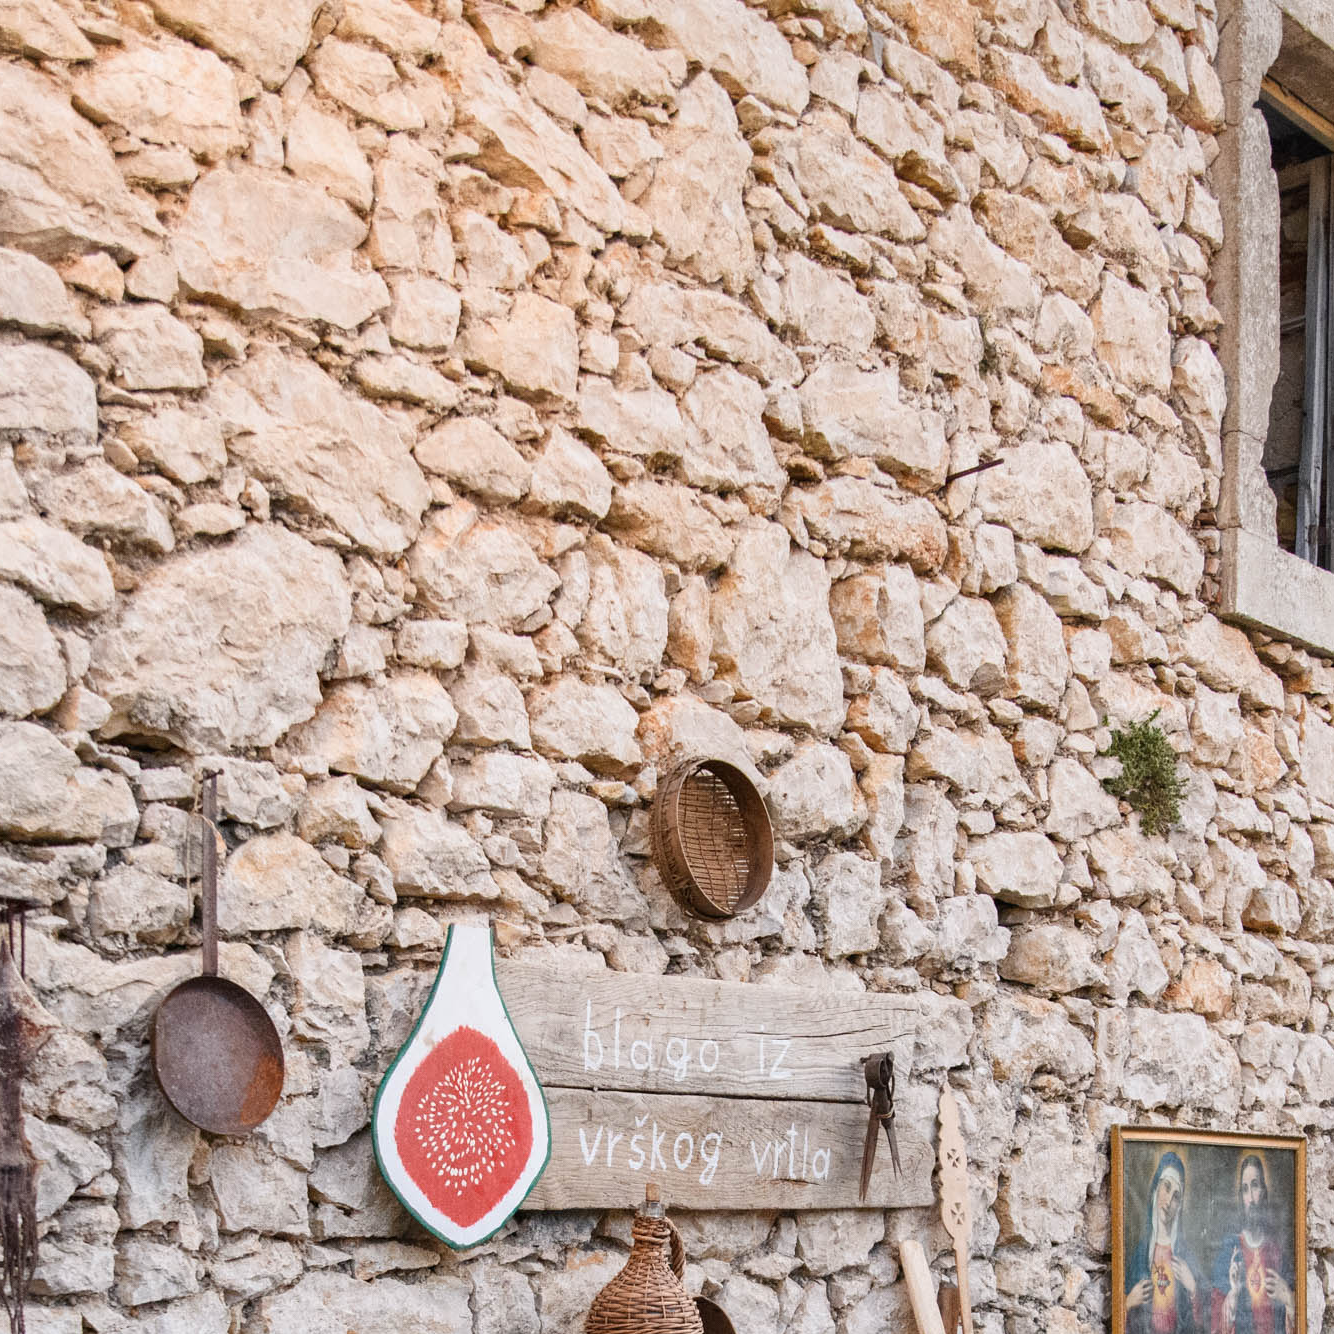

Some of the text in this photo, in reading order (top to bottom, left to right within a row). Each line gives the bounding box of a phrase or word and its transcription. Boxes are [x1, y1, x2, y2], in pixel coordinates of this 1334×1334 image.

[582, 999, 792, 1082] blago iz
[578, 1112, 832, 1186] vrškog vrtla
